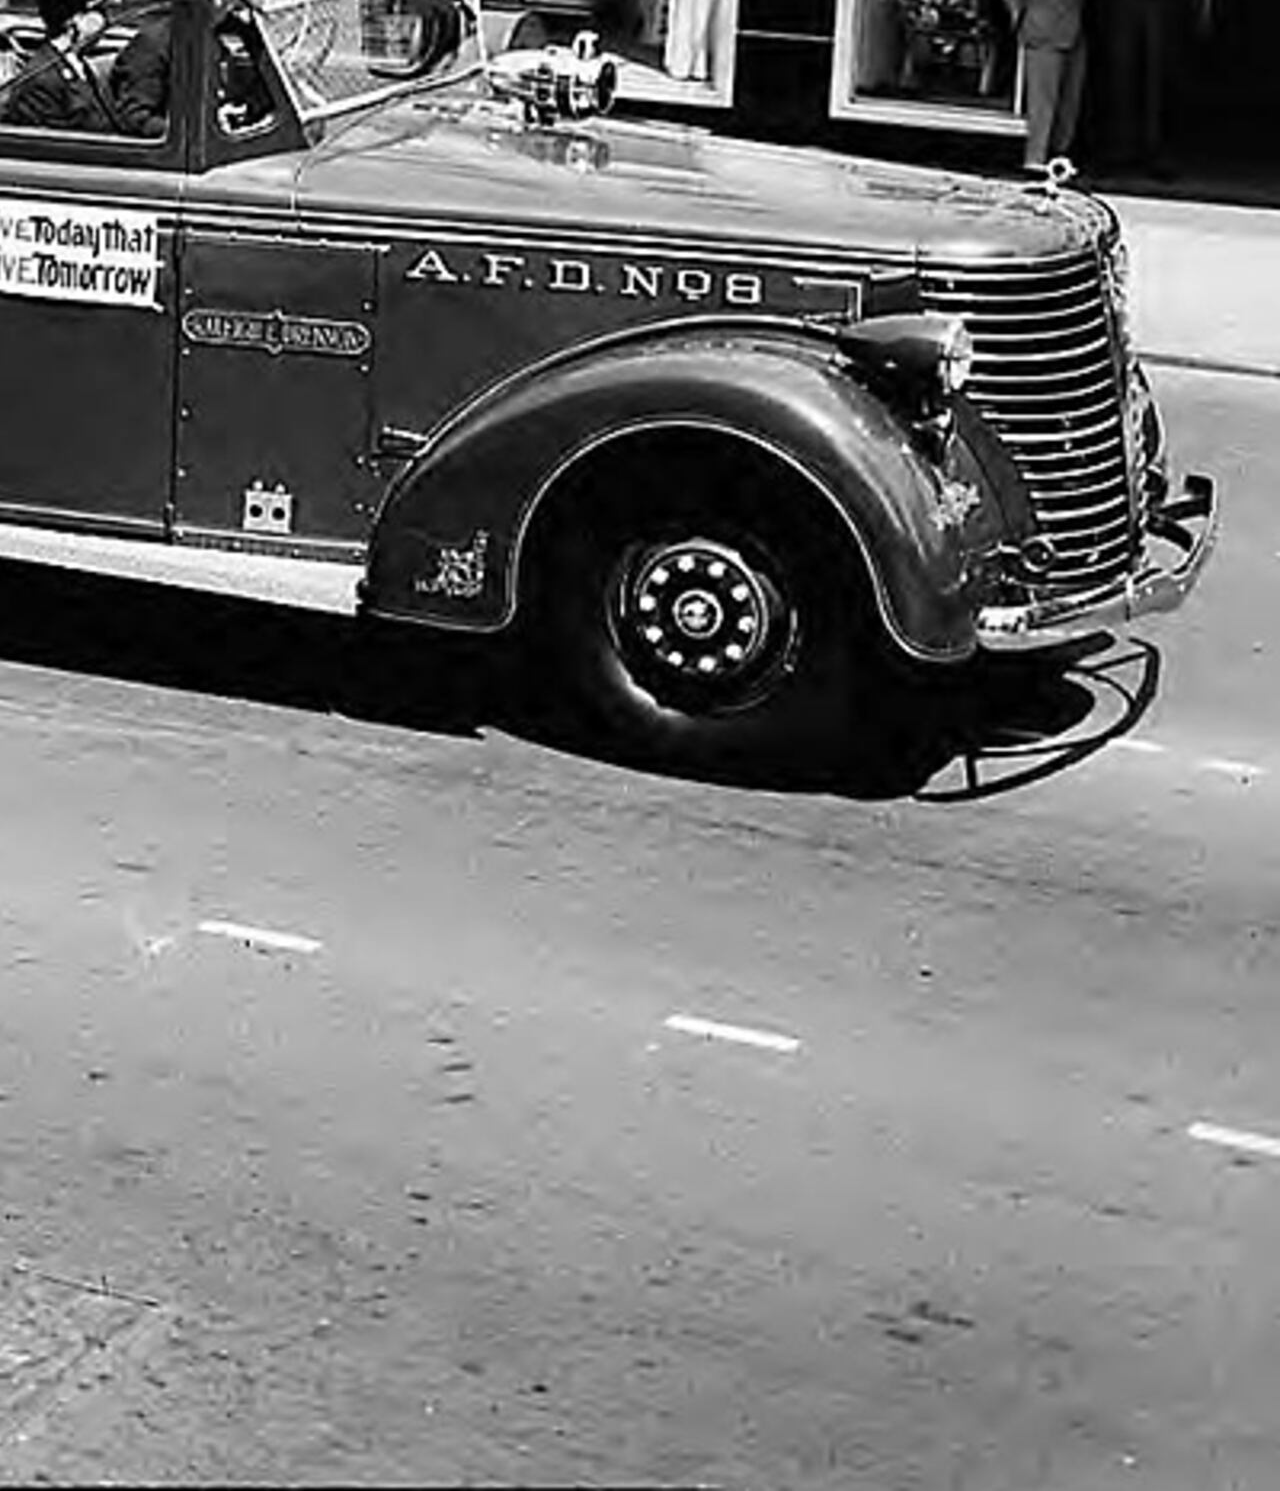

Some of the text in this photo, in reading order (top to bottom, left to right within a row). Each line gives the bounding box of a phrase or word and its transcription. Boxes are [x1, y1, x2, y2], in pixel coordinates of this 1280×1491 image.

[30, 216, 101, 258] Today
[102, 220, 154, 252] That
[33, 251, 151, 296] Tomorrow
